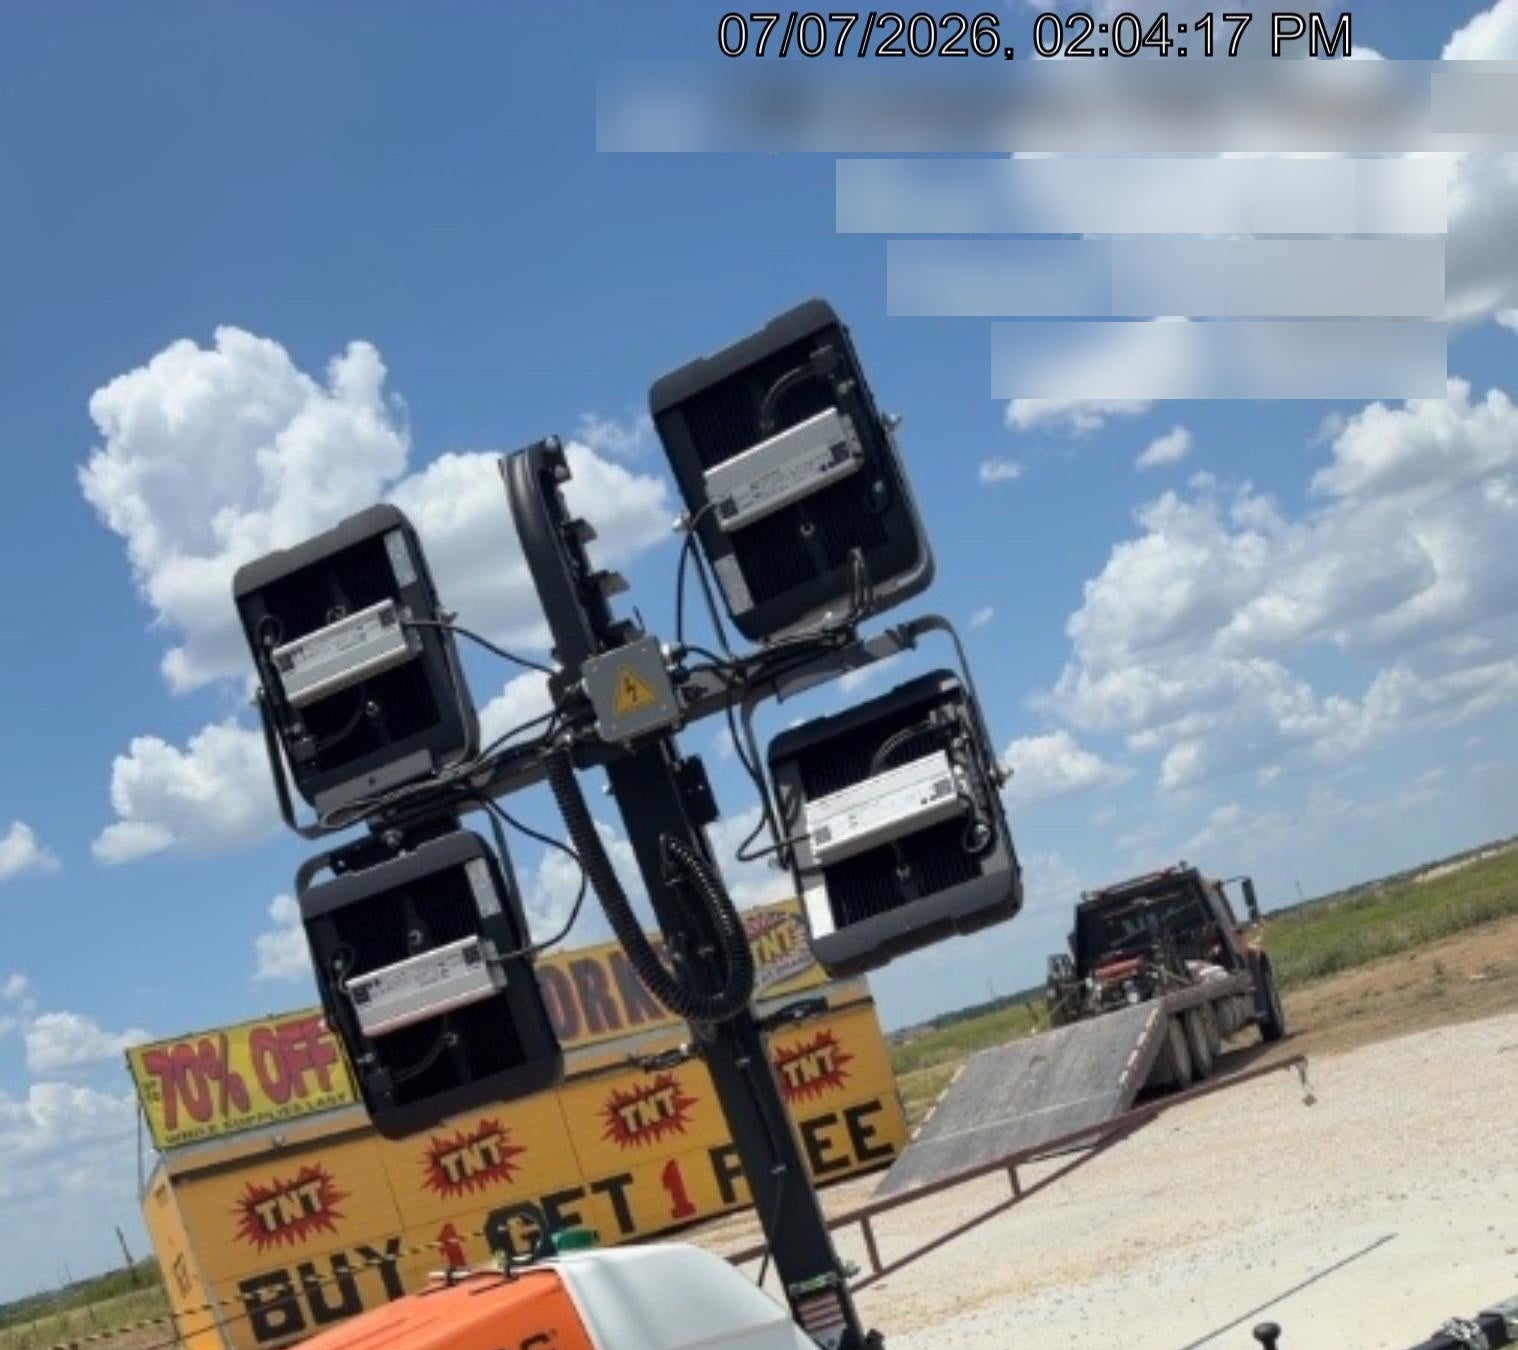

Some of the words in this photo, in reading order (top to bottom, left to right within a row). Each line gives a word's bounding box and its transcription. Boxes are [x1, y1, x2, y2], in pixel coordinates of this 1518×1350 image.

[142, 1033, 250, 1129] 70%
[250, 1016, 336, 1103] OFF
[782, 1043, 836, 1090] TNT
[618, 1085, 676, 1132] TNT
[440, 1137, 503, 1183] TNT
[239, 1239, 405, 1343] BUY
[661, 1158, 697, 1221] 1
[708, 1099, 894, 1205] FEE
[254, 1184, 325, 1232] TNT
